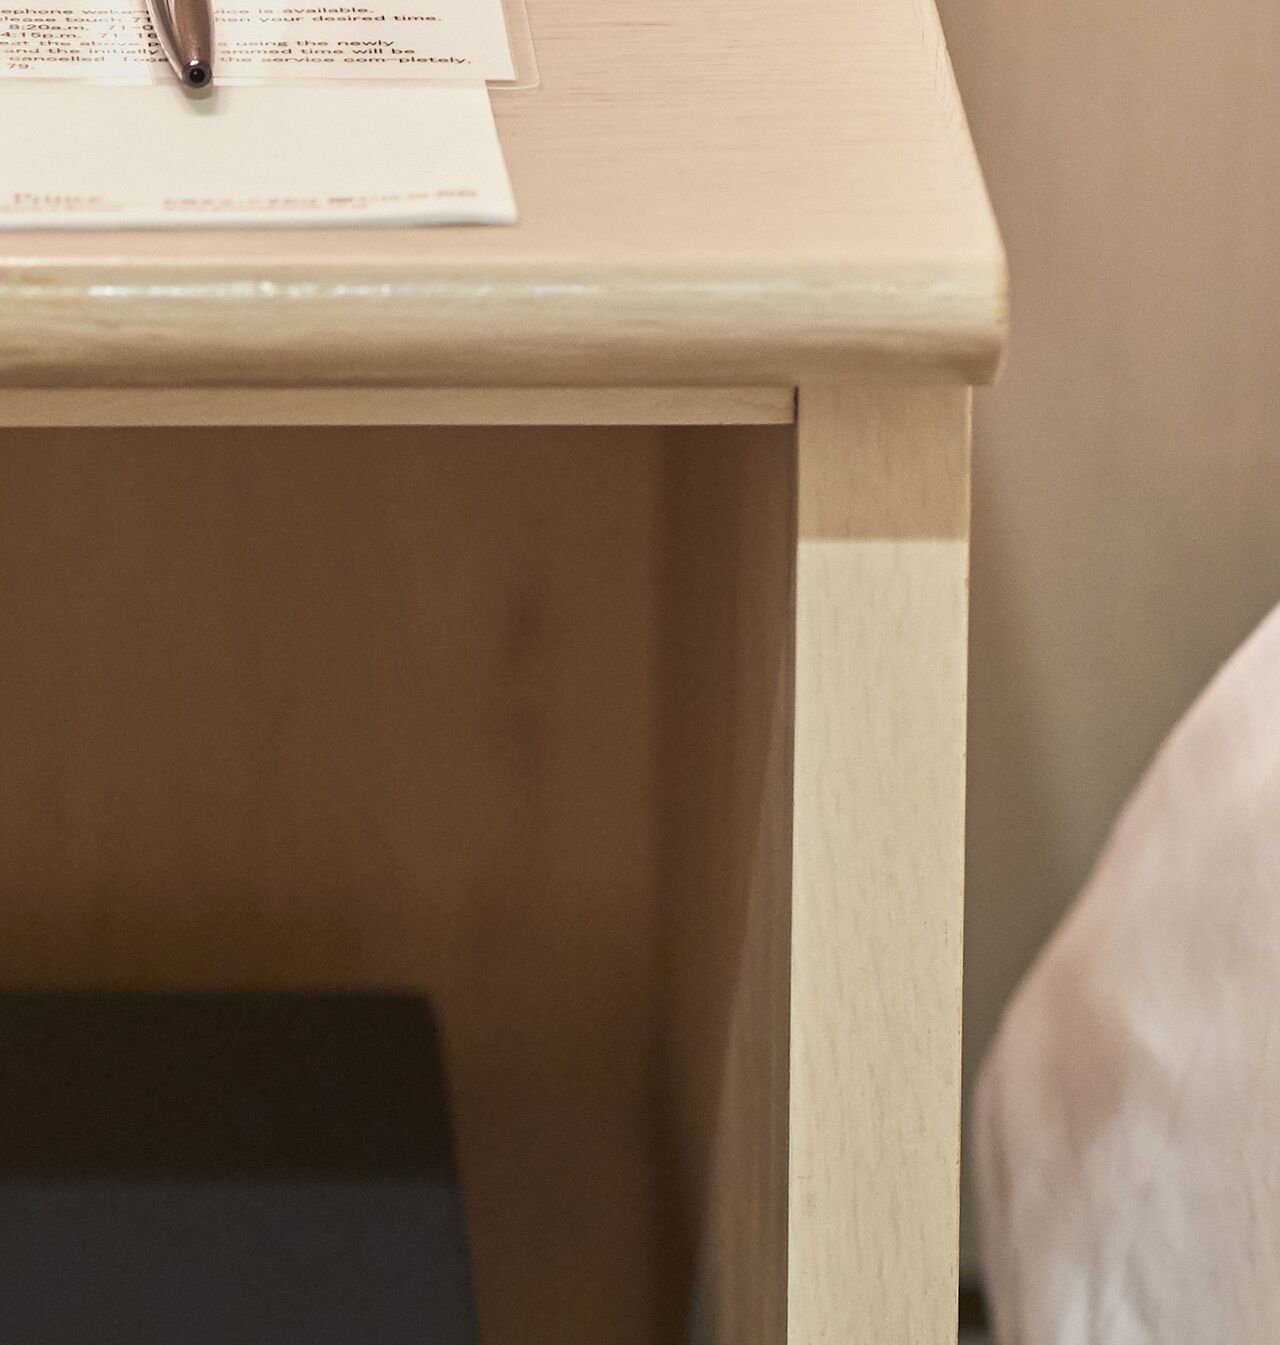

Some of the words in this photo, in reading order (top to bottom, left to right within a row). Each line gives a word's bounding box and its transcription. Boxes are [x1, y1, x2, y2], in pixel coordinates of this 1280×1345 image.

[282, 7, 375, 15] available.
[259, 16, 302, 24] your
[311, 14, 386, 23] desired
[393, 14, 443, 22] time.
[295, 39, 329, 47] the
[337, 39, 394, 48] newly
[47, 47, 81, 55] the
[87, 47, 159, 56] initially
[300, 47, 344, 55] time
[351, 47, 384, 55] will
[390, 47, 415, 55] be
[261, 56, 335, 64] service
